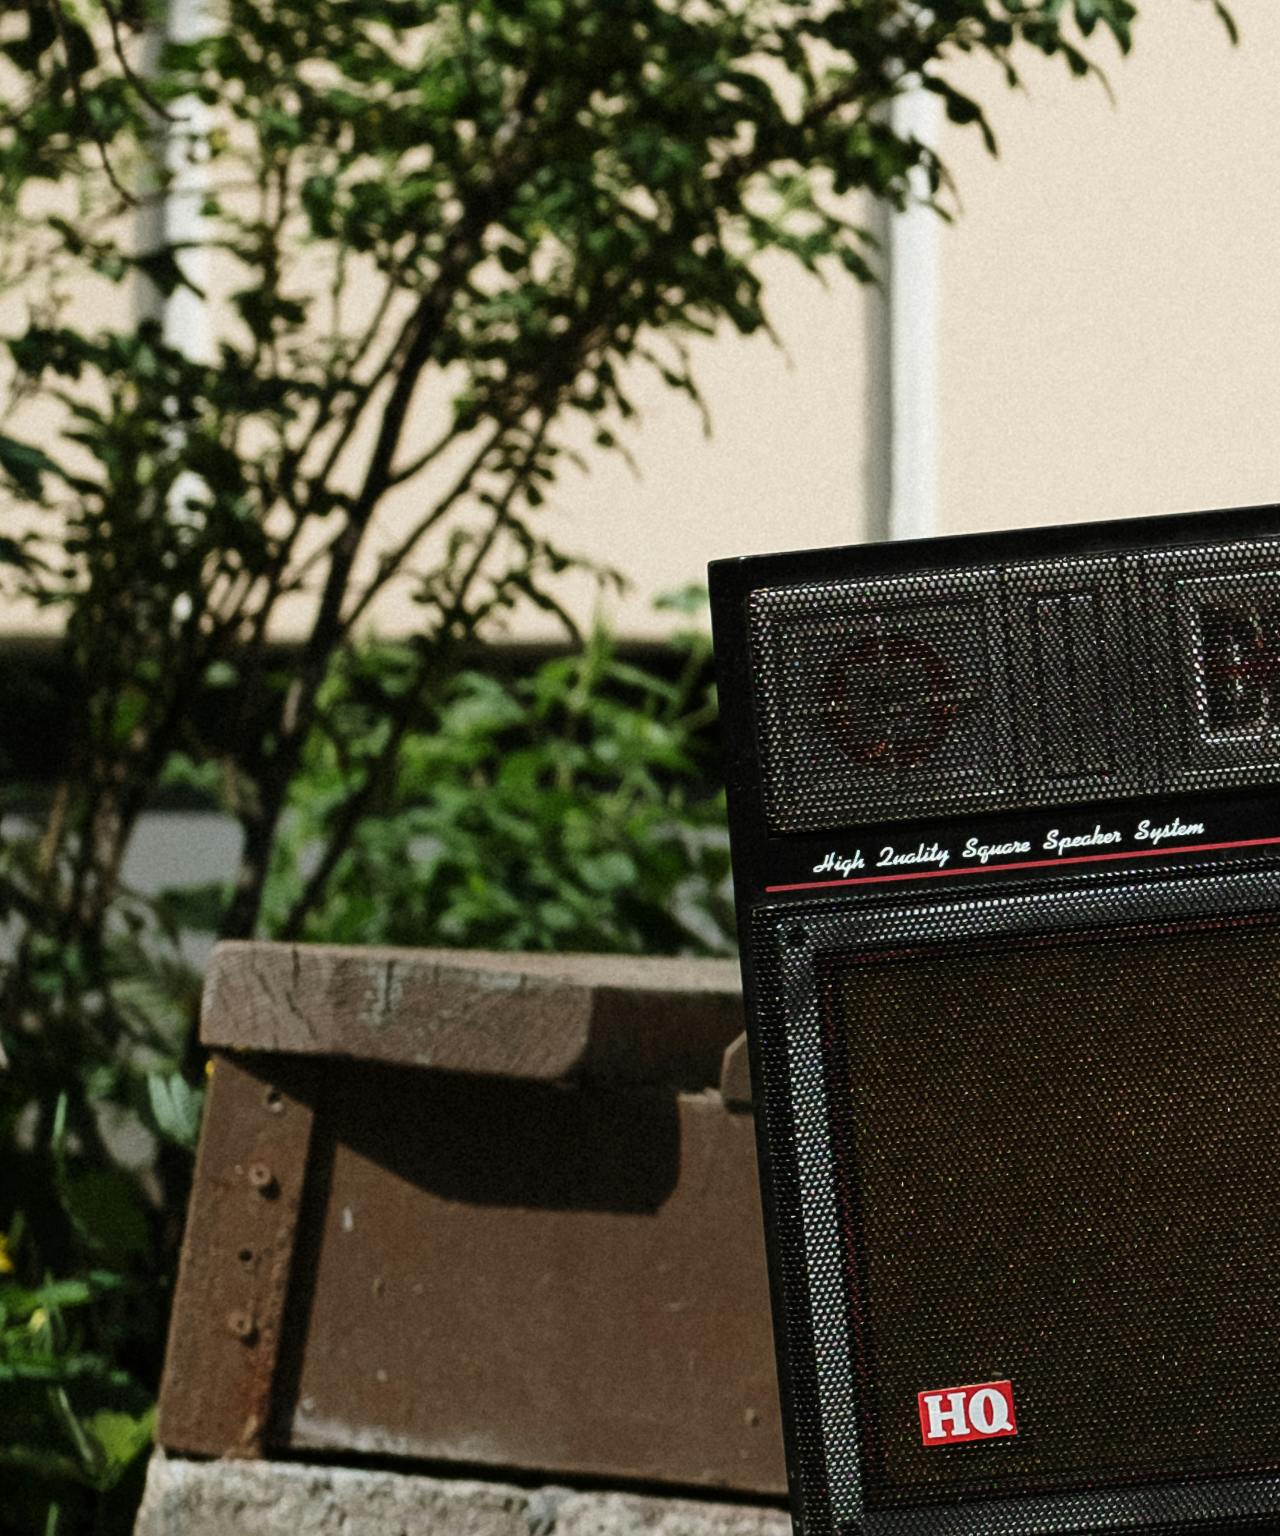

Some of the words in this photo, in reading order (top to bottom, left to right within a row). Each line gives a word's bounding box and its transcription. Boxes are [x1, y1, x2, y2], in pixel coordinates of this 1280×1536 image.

[814, 852, 865, 875] High
[876, 843, 950, 869] Quality
[961, 836, 1031, 862] Square
[1042, 828, 1121, 853] Speaker
[1133, 817, 1204, 846] System
[924, 1387, 1014, 1439] HQ
